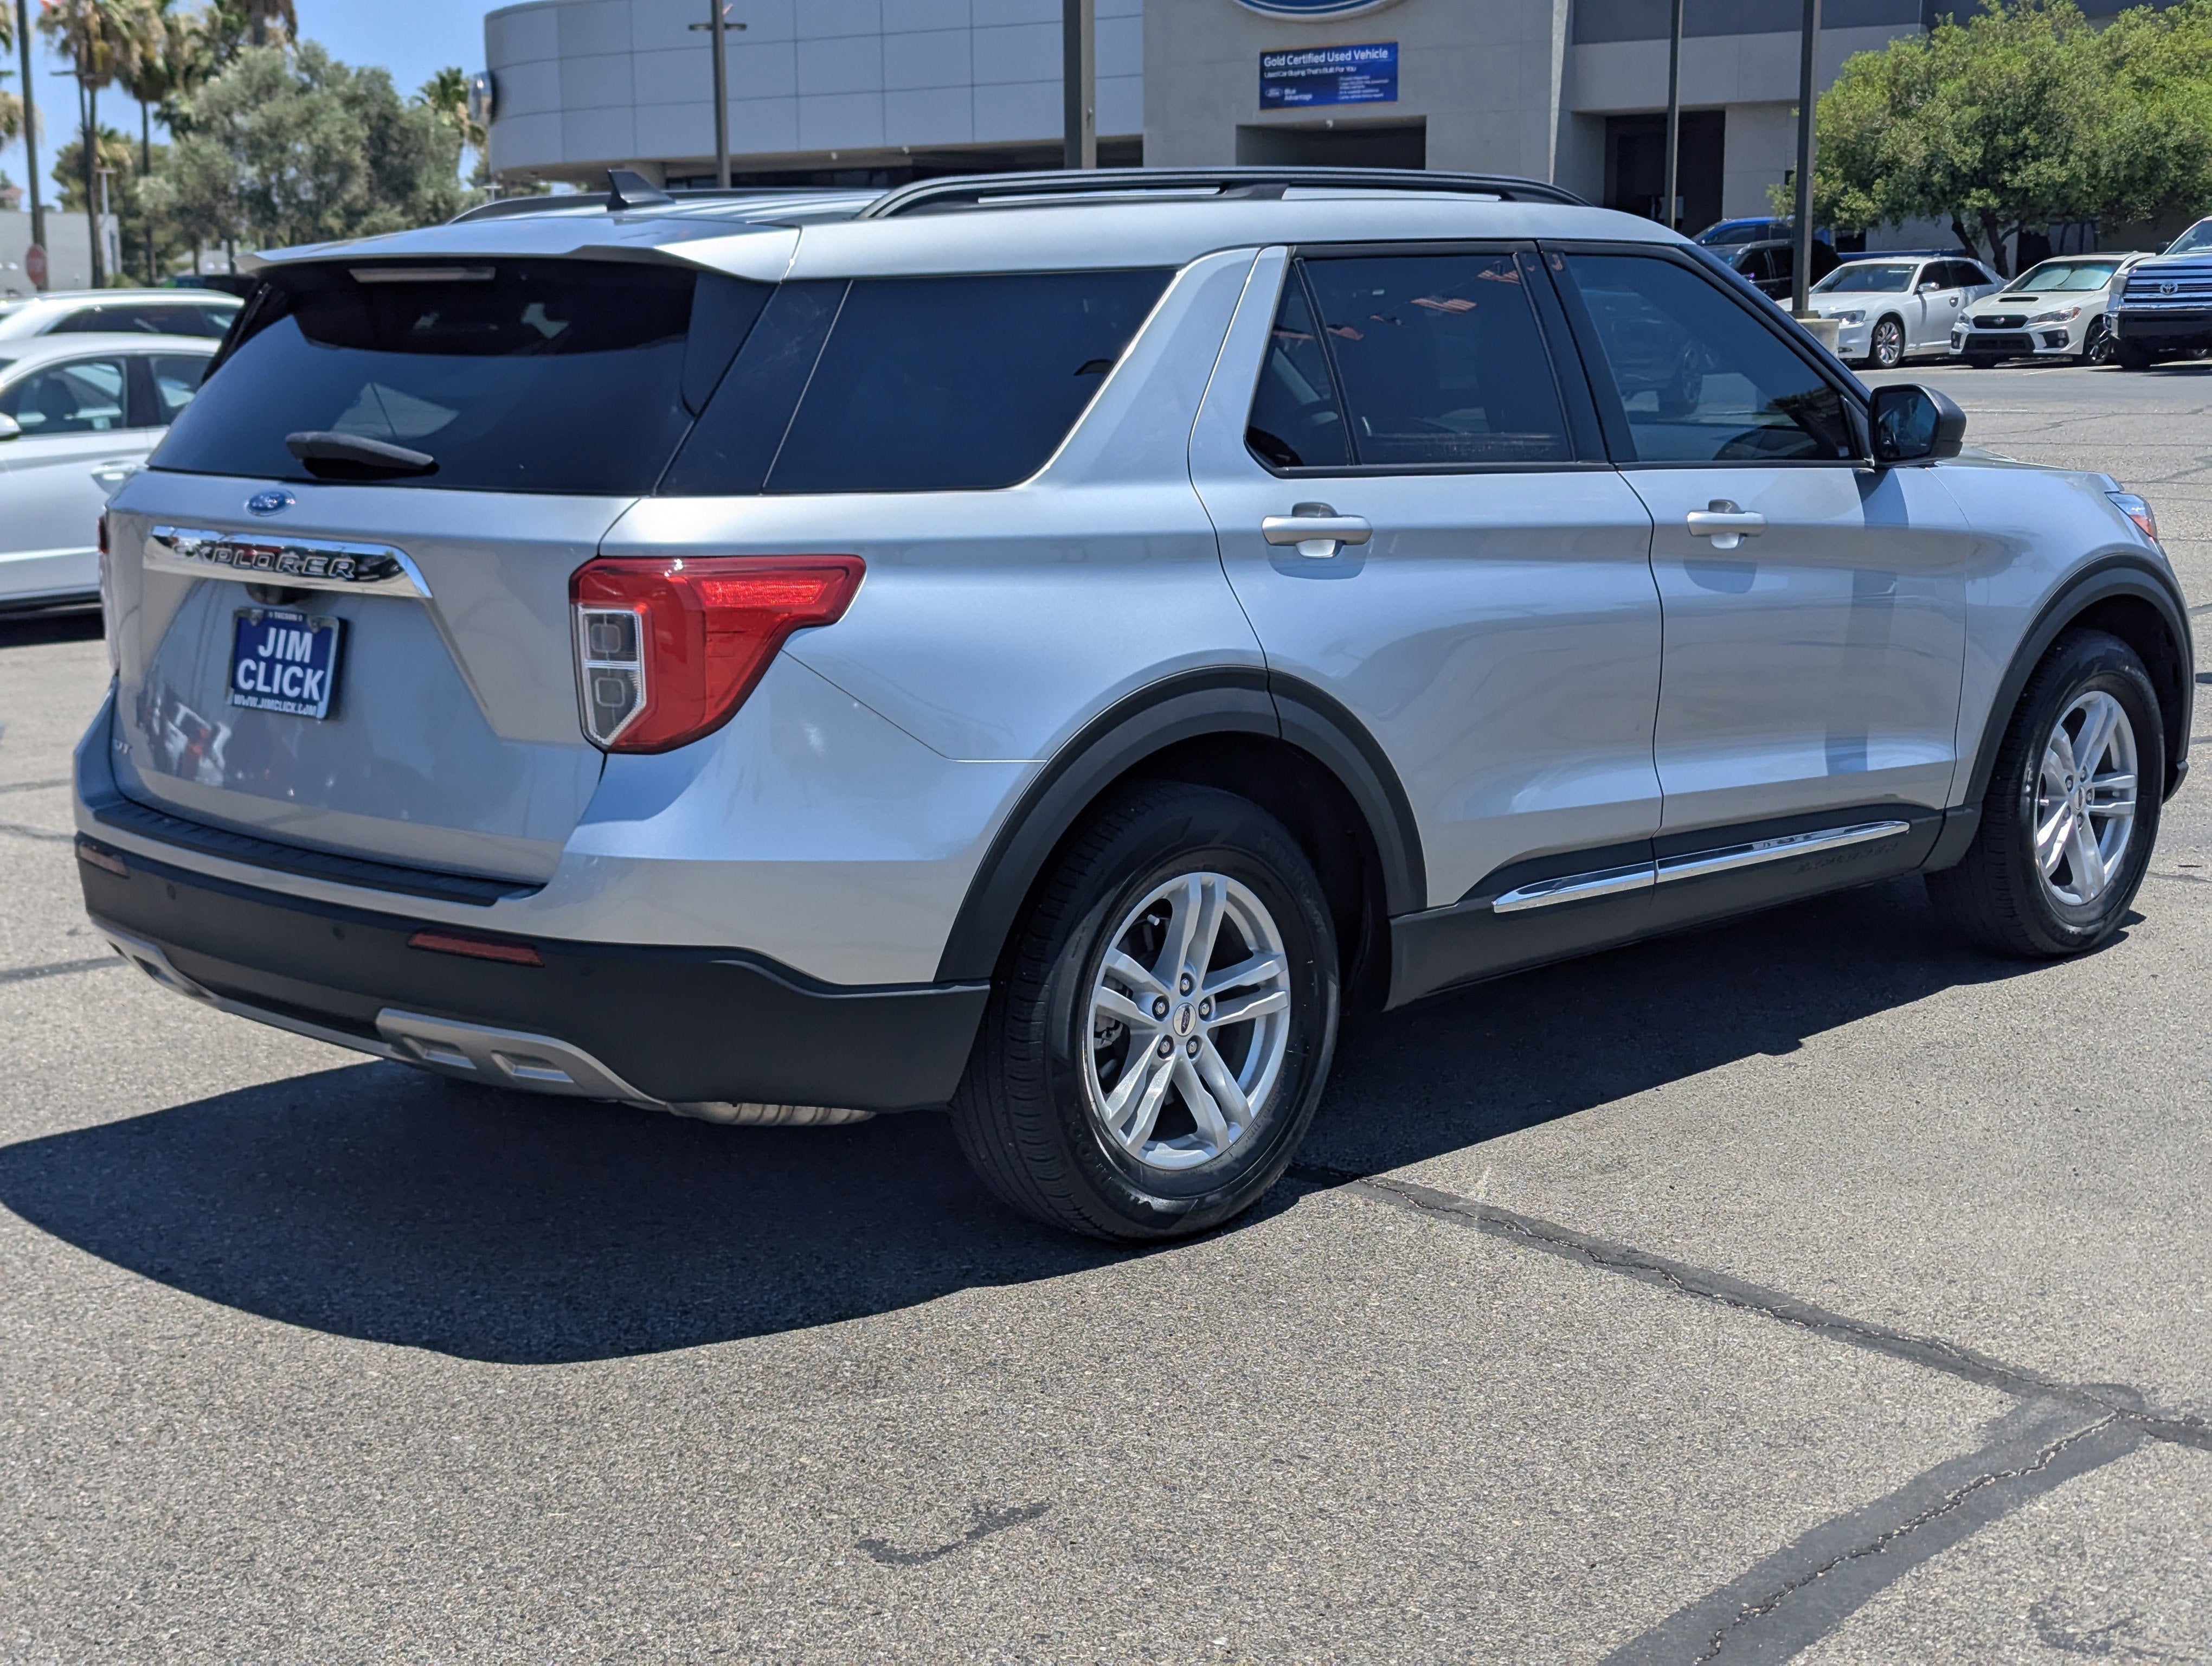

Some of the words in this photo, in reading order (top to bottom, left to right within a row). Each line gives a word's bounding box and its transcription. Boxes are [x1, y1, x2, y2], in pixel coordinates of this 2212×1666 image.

[1264, 55, 1285, 67] Gold
[1287, 52, 1326, 65] Certified
[1327, 50, 1352, 62] Used
[1353, 48, 1388, 60] Vehicle
[172, 542, 356, 579] EXPLORER
[258, 626, 313, 663] JIM
[237, 658, 325, 701] CLICK
